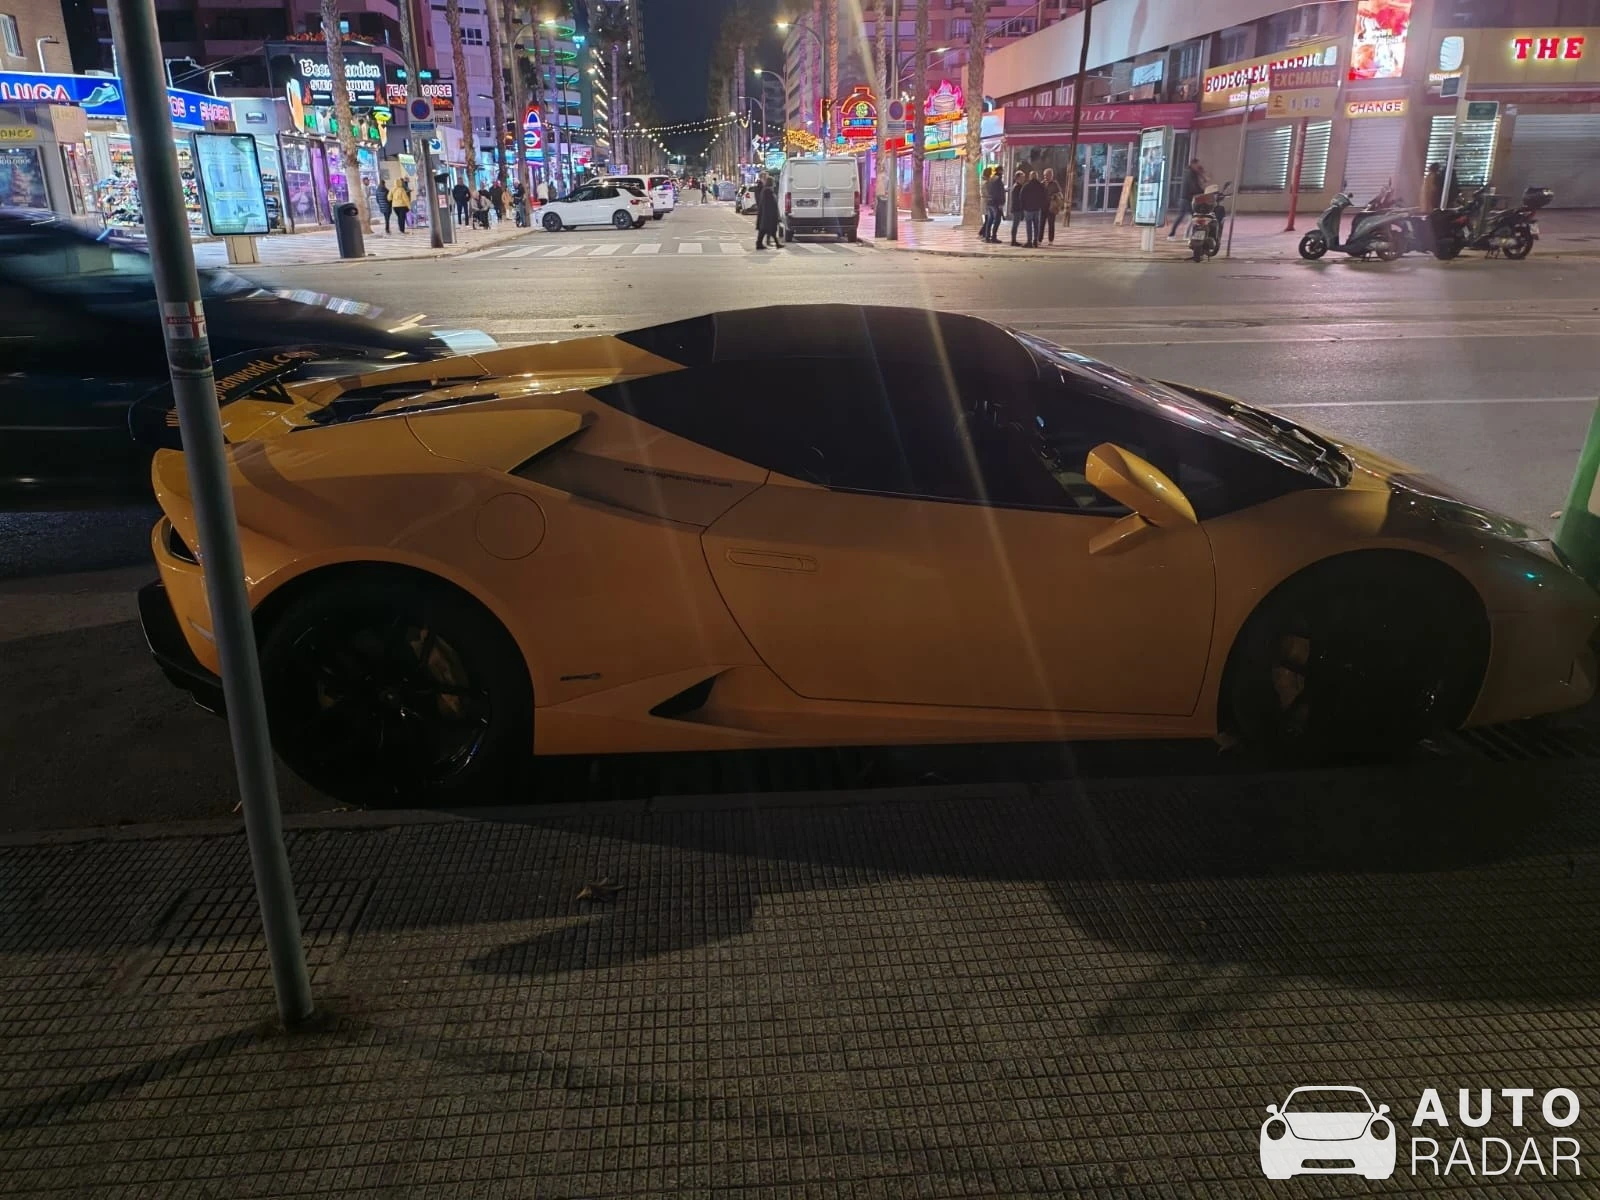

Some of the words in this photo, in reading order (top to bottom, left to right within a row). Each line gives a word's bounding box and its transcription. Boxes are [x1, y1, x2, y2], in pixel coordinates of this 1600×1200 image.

[1511, 36, 1585, 60] THE
[300, 59, 331, 77] Beer
[344, 60, 381, 77] arden
[1274, 69, 1338, 87] EXCHANGE
[200, 102, 230, 121] SHOES
[1349, 102, 1402, 113] CHANGE
